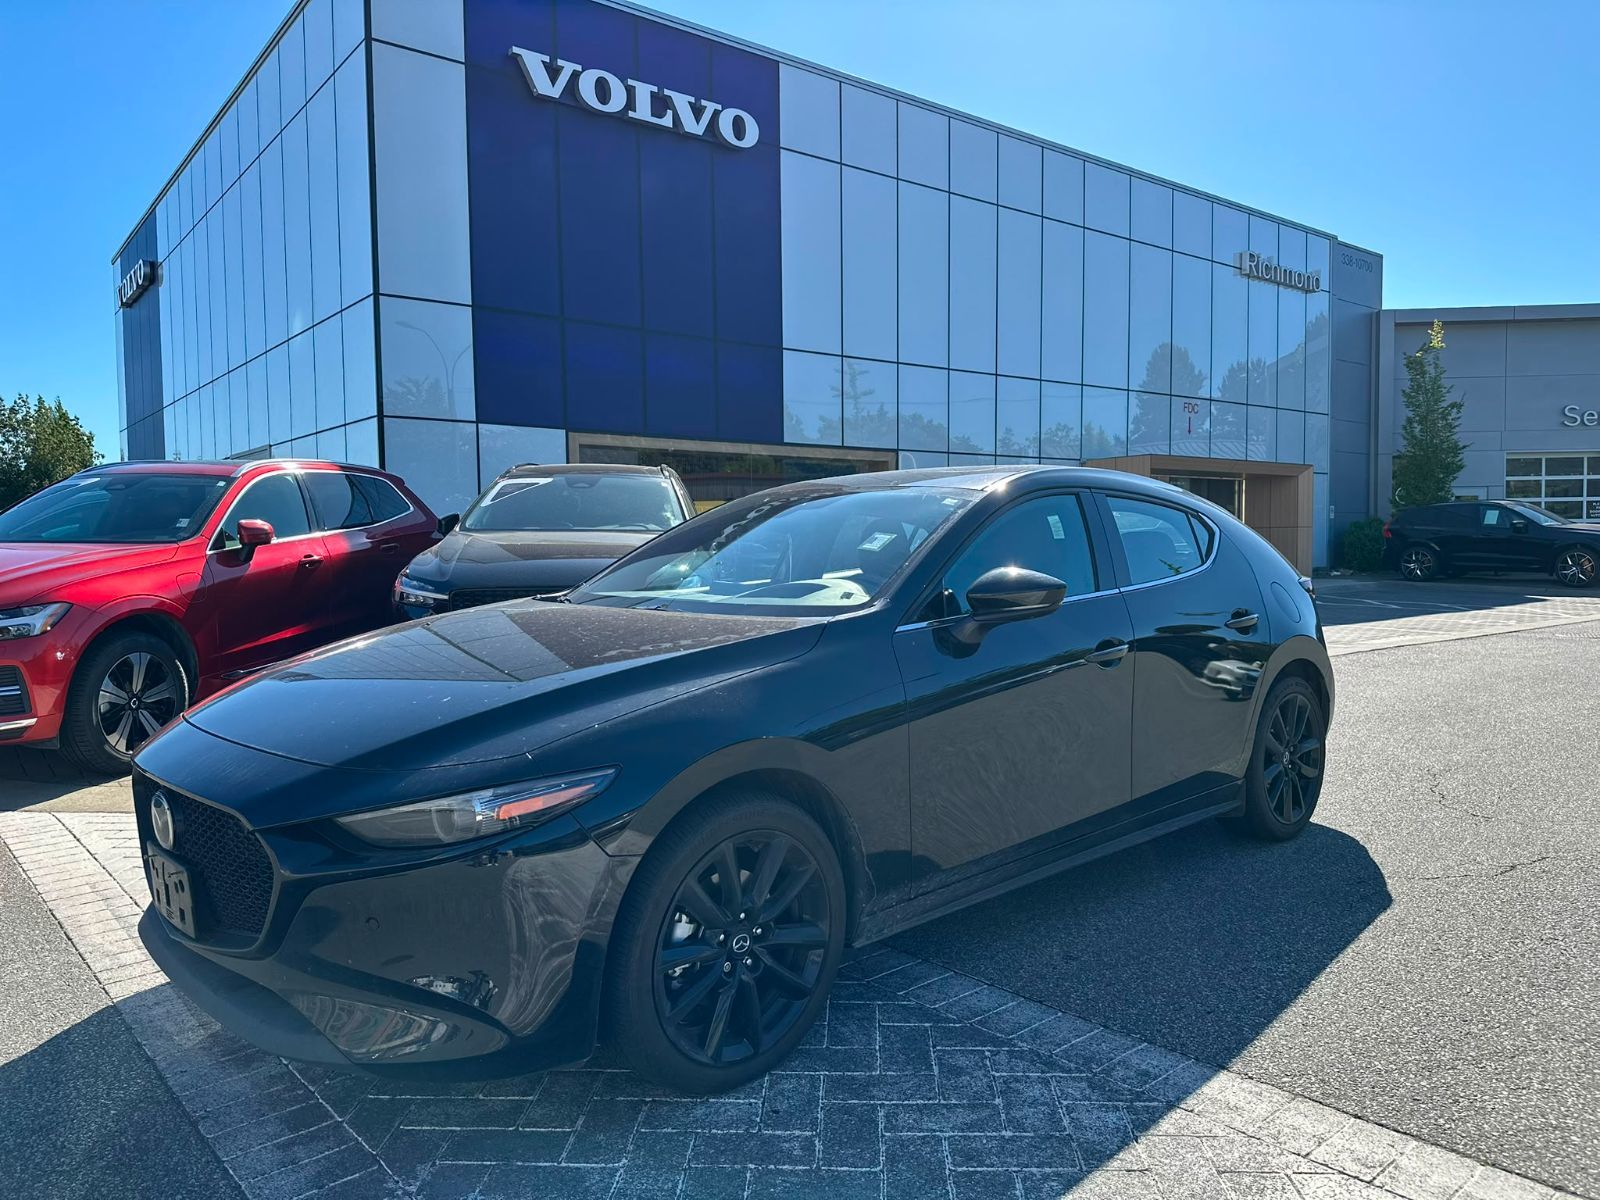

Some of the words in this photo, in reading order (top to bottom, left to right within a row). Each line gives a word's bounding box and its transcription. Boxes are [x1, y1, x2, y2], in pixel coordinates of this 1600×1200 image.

[508, 45, 760, 149] VOLVO
[117, 258, 144, 308] VOLVO
[1243, 250, 1321, 292] Richmond
[1183, 402, 1199, 414] FDC
